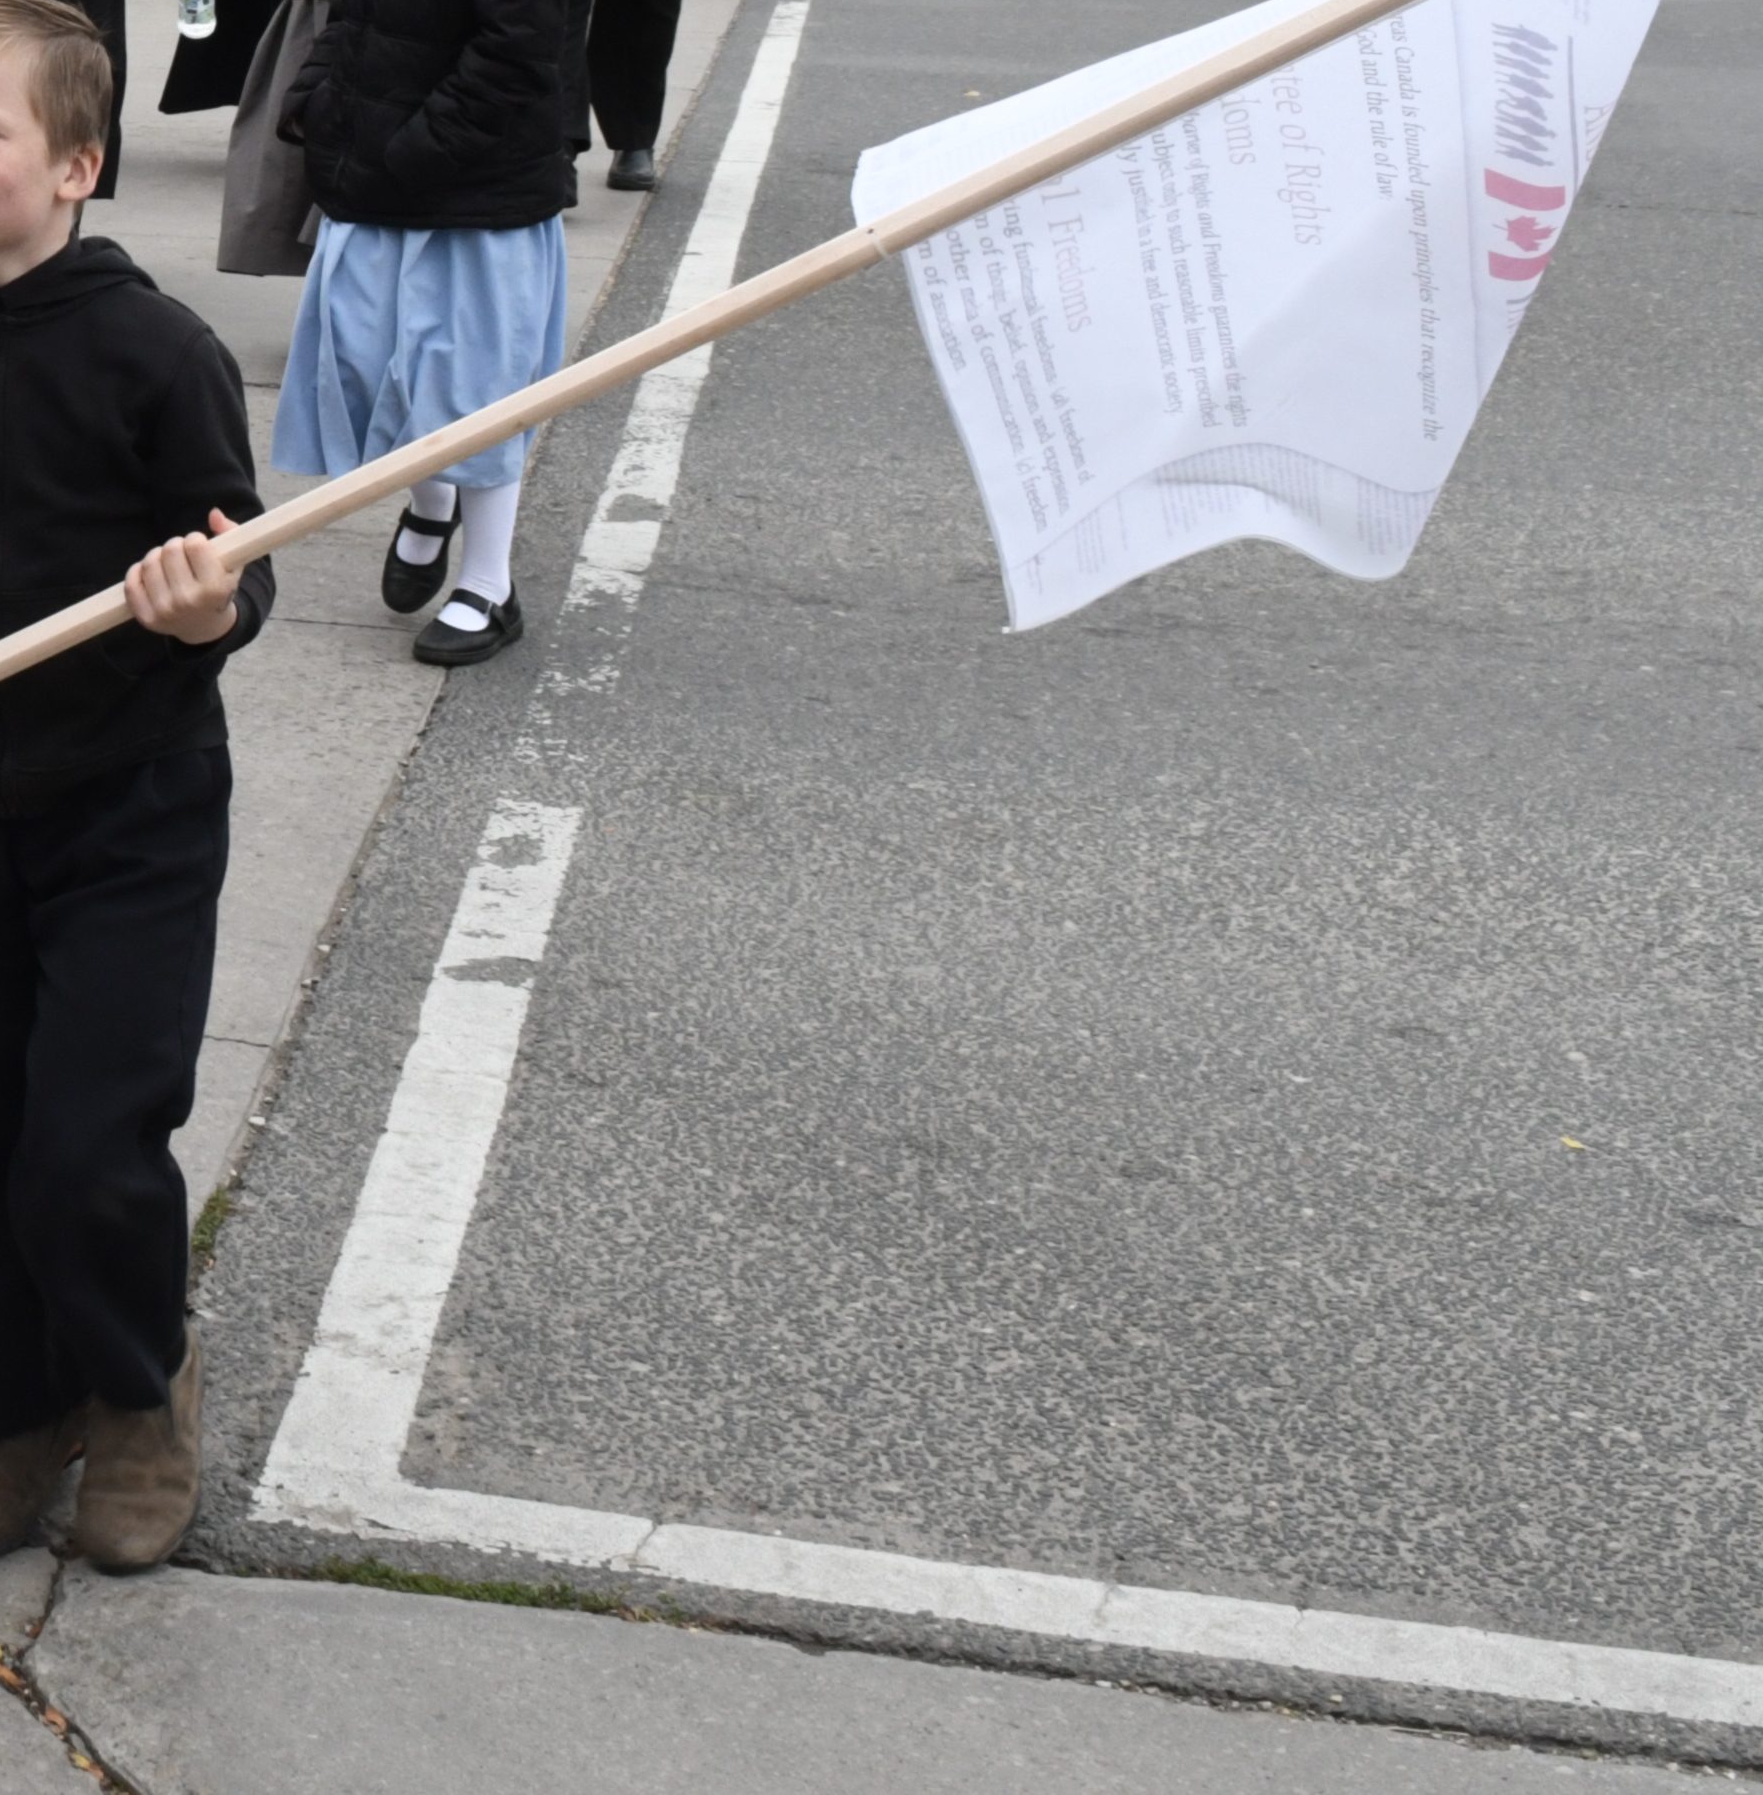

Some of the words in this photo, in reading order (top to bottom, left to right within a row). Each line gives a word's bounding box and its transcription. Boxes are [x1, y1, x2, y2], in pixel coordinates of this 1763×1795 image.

[1363, 66, 1381, 93] and
[1393, 46, 1416, 104] Canada
[1367, 95, 1388, 117] the
[1404, 108, 1418, 119] is
[1277, 123, 1324, 160] of
[1374, 121, 1394, 150] rule
[1404, 123, 1430, 181] founded
[1373, 153, 1398, 172] of
[1190, 171, 1215, 207] Rights
[1276, 162, 1332, 247] Rights
[1405, 186, 1430, 222] upon
[1171, 222, 1193, 255] such
[1198, 211, 1222, 239] and
[923, 265, 948, 287] of
[1048, 215, 1097, 334] Freedoms
[1141, 247, 1159, 274] free
[1202, 243, 1229, 303] Freedoms
[1408, 226, 1436, 305] principles
[945, 227, 972, 284] other
[970, 325, 994, 346] of
[1145, 274, 1167, 301] and
[1173, 257, 1200, 325] reasonable
[979, 234, 1005, 260] of
[1032, 417, 1057, 447] and
[1150, 302, 1178, 371] democratic
[1208, 303, 1240, 371] guarantees
[1420, 310, 1440, 343] that
[1186, 326, 1207, 365] limits
[1163, 372, 1184, 415] society
[1187, 366, 1223, 429] prescribed
[1225, 372, 1247, 392] the
[1416, 348, 1441, 419] recognize
[1225, 392, 1252, 429] rights
[1423, 421, 1443, 441] the
